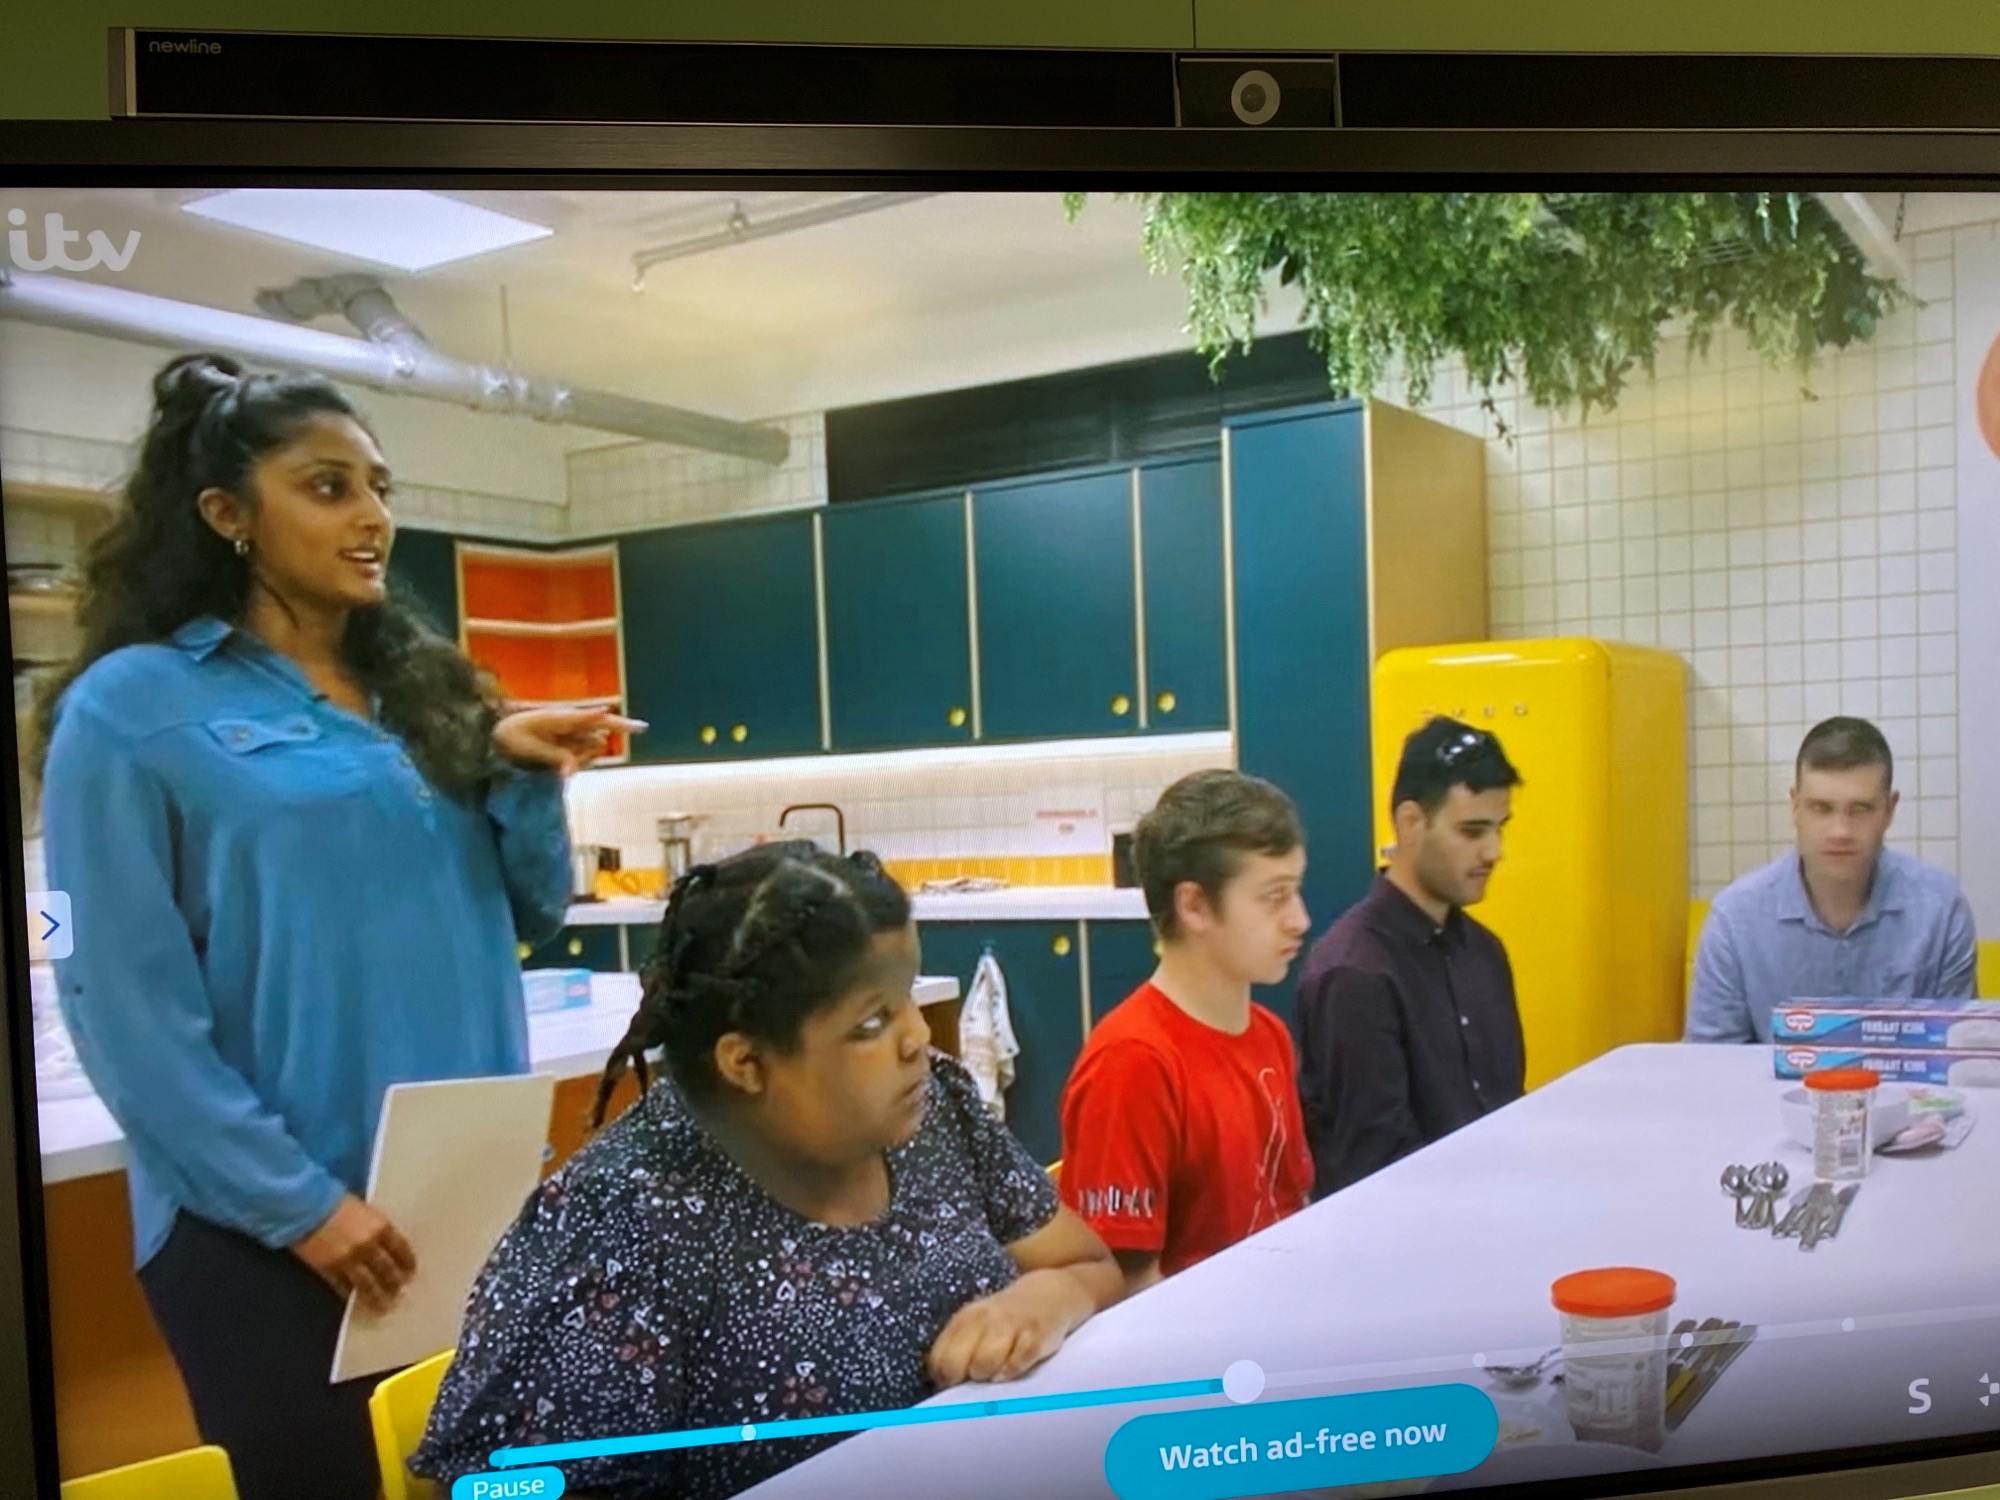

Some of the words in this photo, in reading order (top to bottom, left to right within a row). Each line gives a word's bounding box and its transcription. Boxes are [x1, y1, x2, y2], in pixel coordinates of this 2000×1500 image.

[149, 39, 222, 54] newline
[8, 208, 141, 272] itv
[1908, 1378, 1932, 1414] S
[1159, 1437, 1258, 1471] Watch
[1266, 1428, 1376, 1460] ad-free
[1385, 1423, 1447, 1447] now
[473, 1478, 545, 1500] Pause
